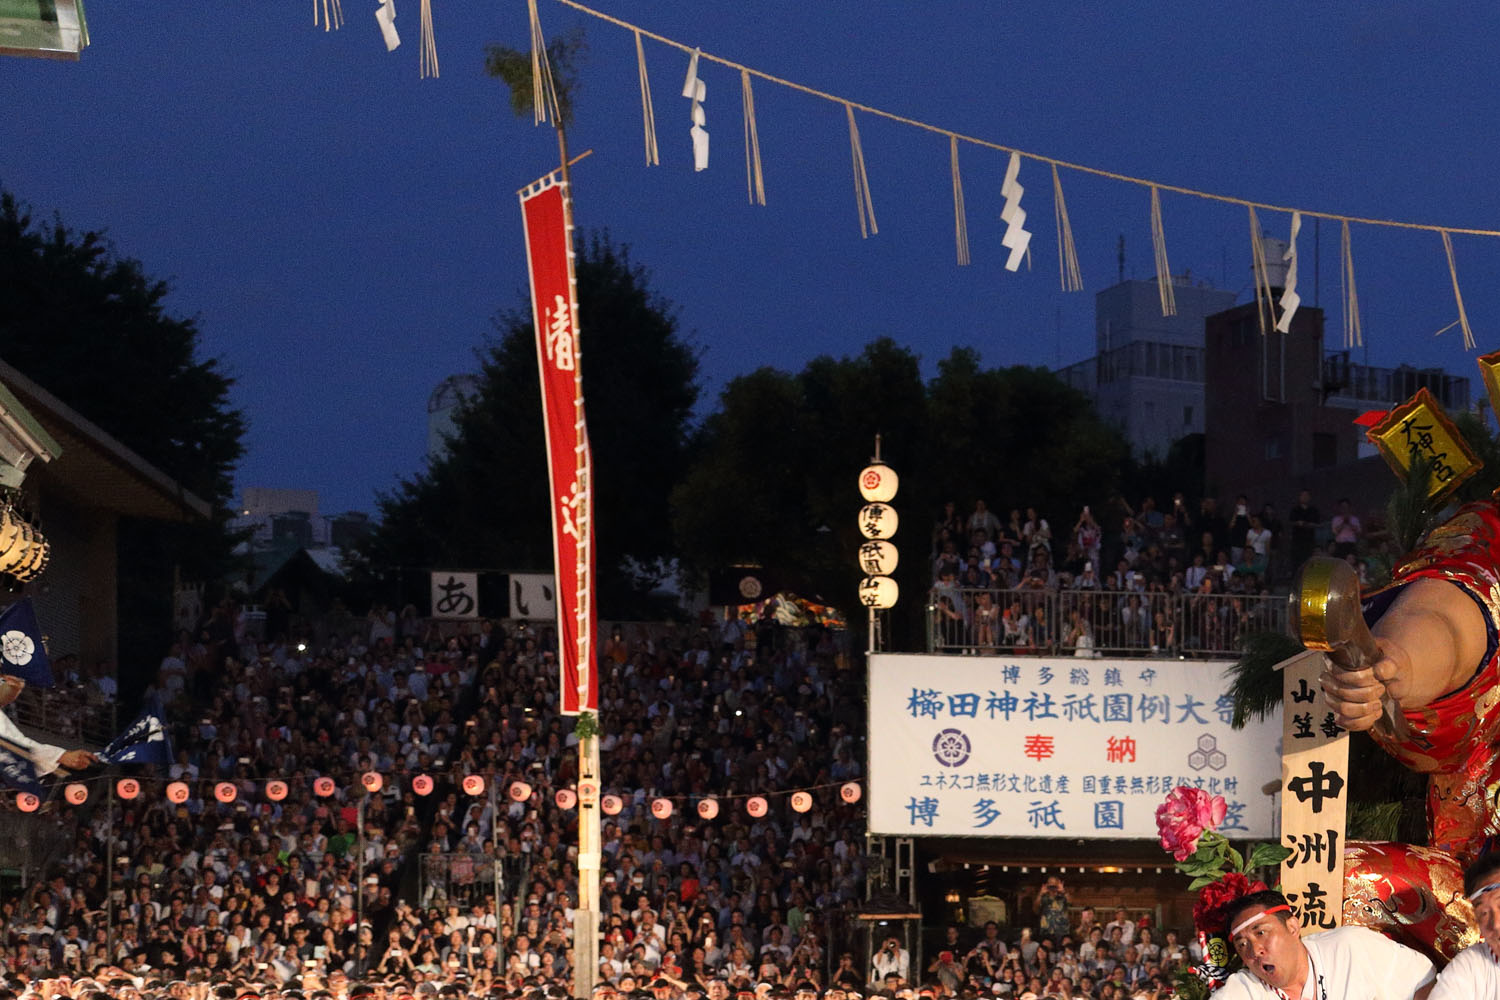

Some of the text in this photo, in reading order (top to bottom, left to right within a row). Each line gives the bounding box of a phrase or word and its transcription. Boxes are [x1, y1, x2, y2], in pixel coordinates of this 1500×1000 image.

[437, 576, 552, 615] あ い
[1001, 665, 1158, 687] 博多総鎮守
[1291, 679, 1316, 739] 山笠
[1024, 734, 1137, 763] 奉納
[919, 772, 1070, 795] ユネスコ無形文化遺産
[905, 797, 1249, 832] 博多祇園笠
[1287, 761, 1345, 930] 中洲流
